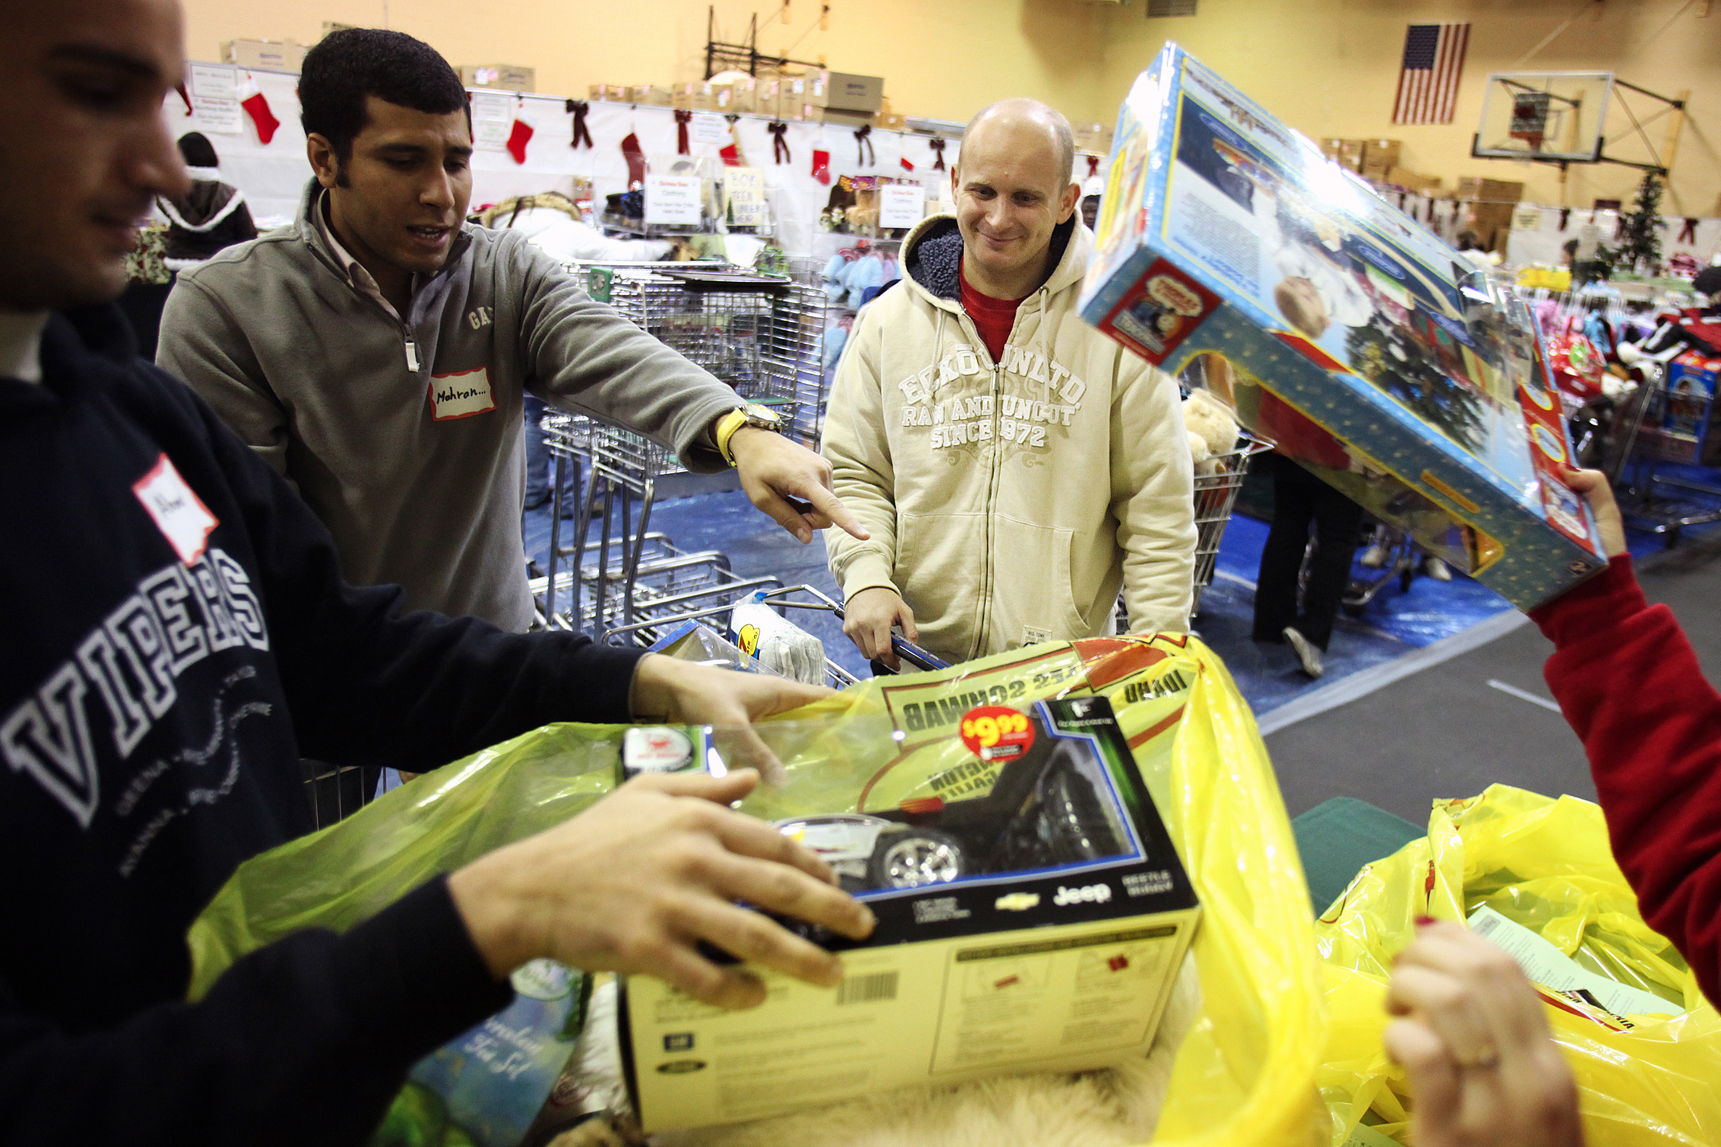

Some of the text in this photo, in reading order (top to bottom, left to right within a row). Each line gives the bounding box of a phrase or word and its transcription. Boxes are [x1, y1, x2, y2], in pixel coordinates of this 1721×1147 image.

[468, 306, 493, 330] GA
[901, 394, 1078, 428] RAW AND UNCUT
[930, 416, 1046, 450] SINCE 1972
[0, 547, 270, 831] VIPERS
[1053, 883, 1112, 906] Jeep
